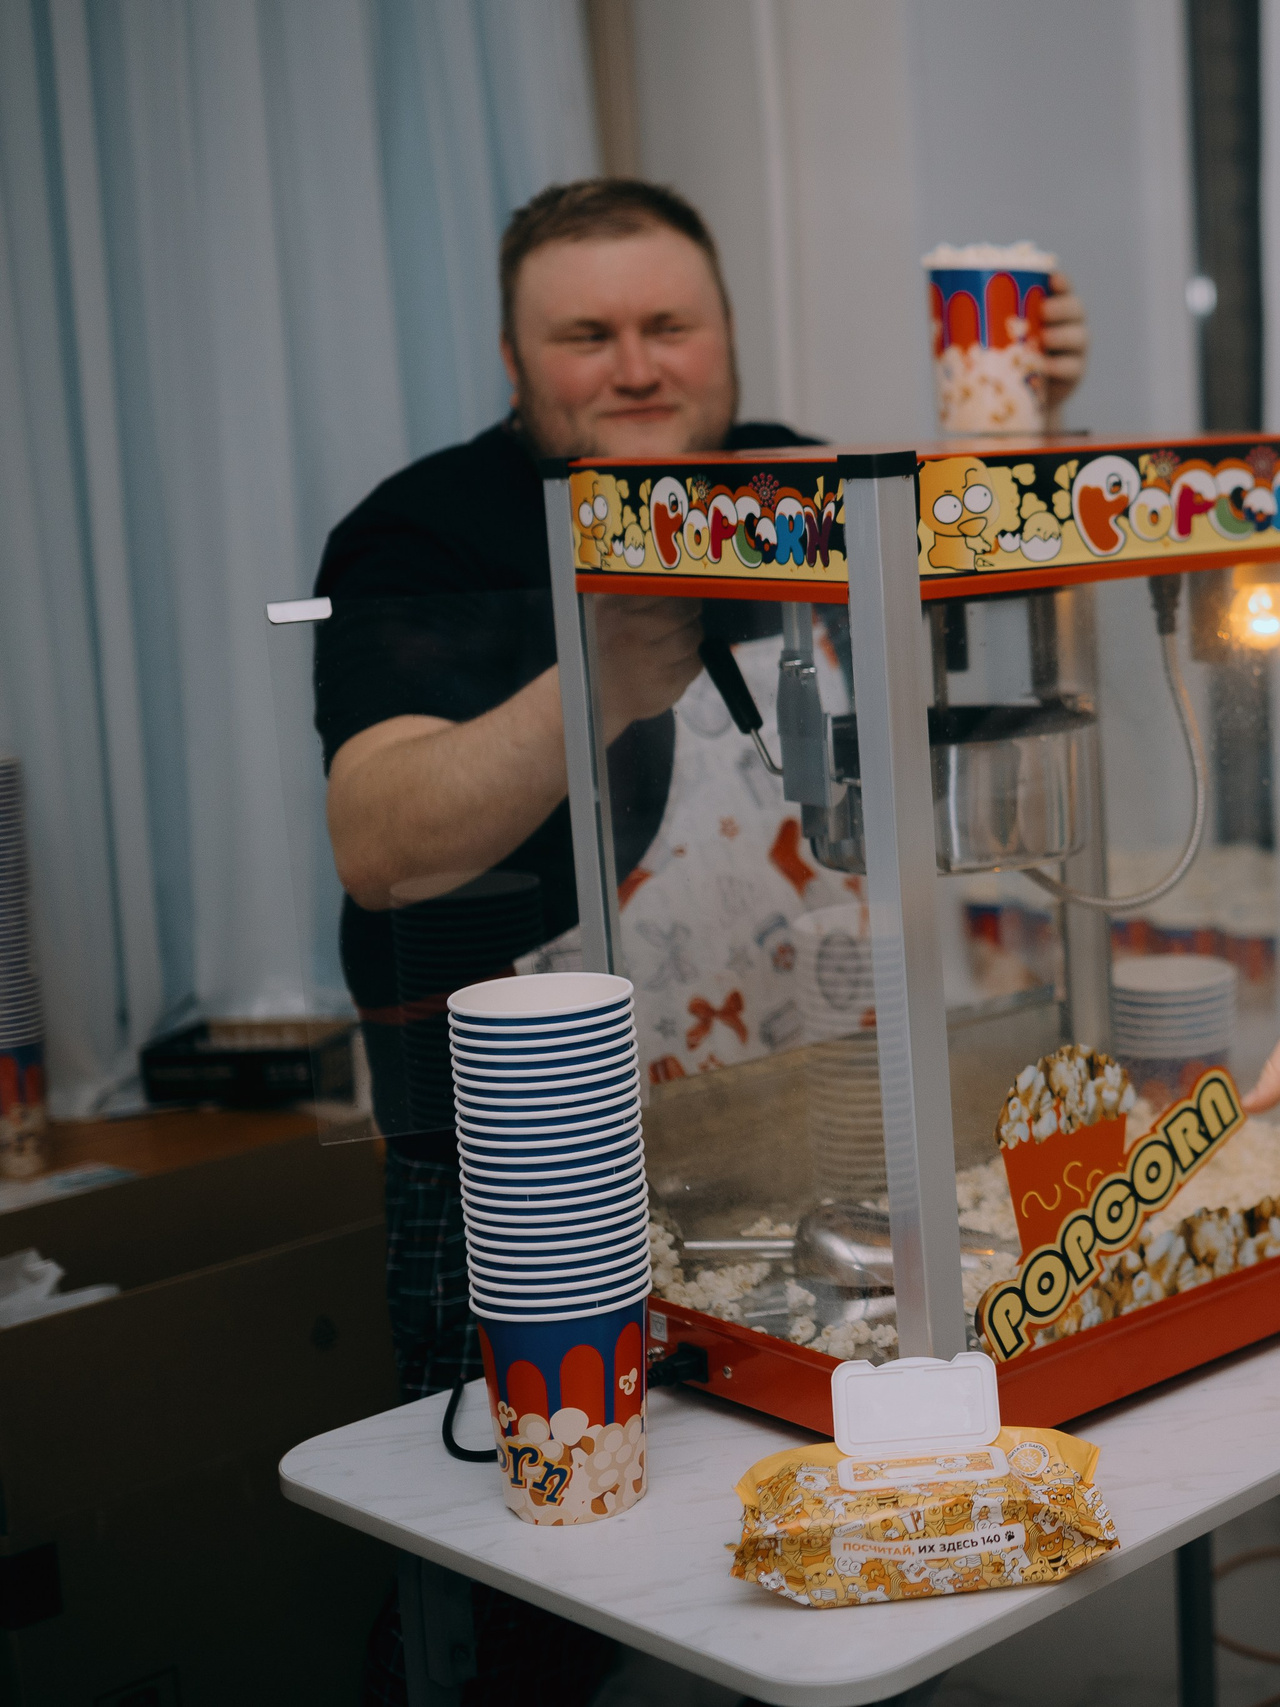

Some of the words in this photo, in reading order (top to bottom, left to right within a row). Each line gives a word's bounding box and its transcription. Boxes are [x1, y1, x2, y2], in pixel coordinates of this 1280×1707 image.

[650, 476, 836, 569] POPCORN
[988, 1077, 1238, 1359] POPCORN
[842, 1542, 915, 1557] ПОСЧИТАЙ,
[918, 1544, 936, 1555] ИХ
[939, 1539, 979, 1552] ЗДЕСЬ
[981, 1533, 1001, 1545] 140
